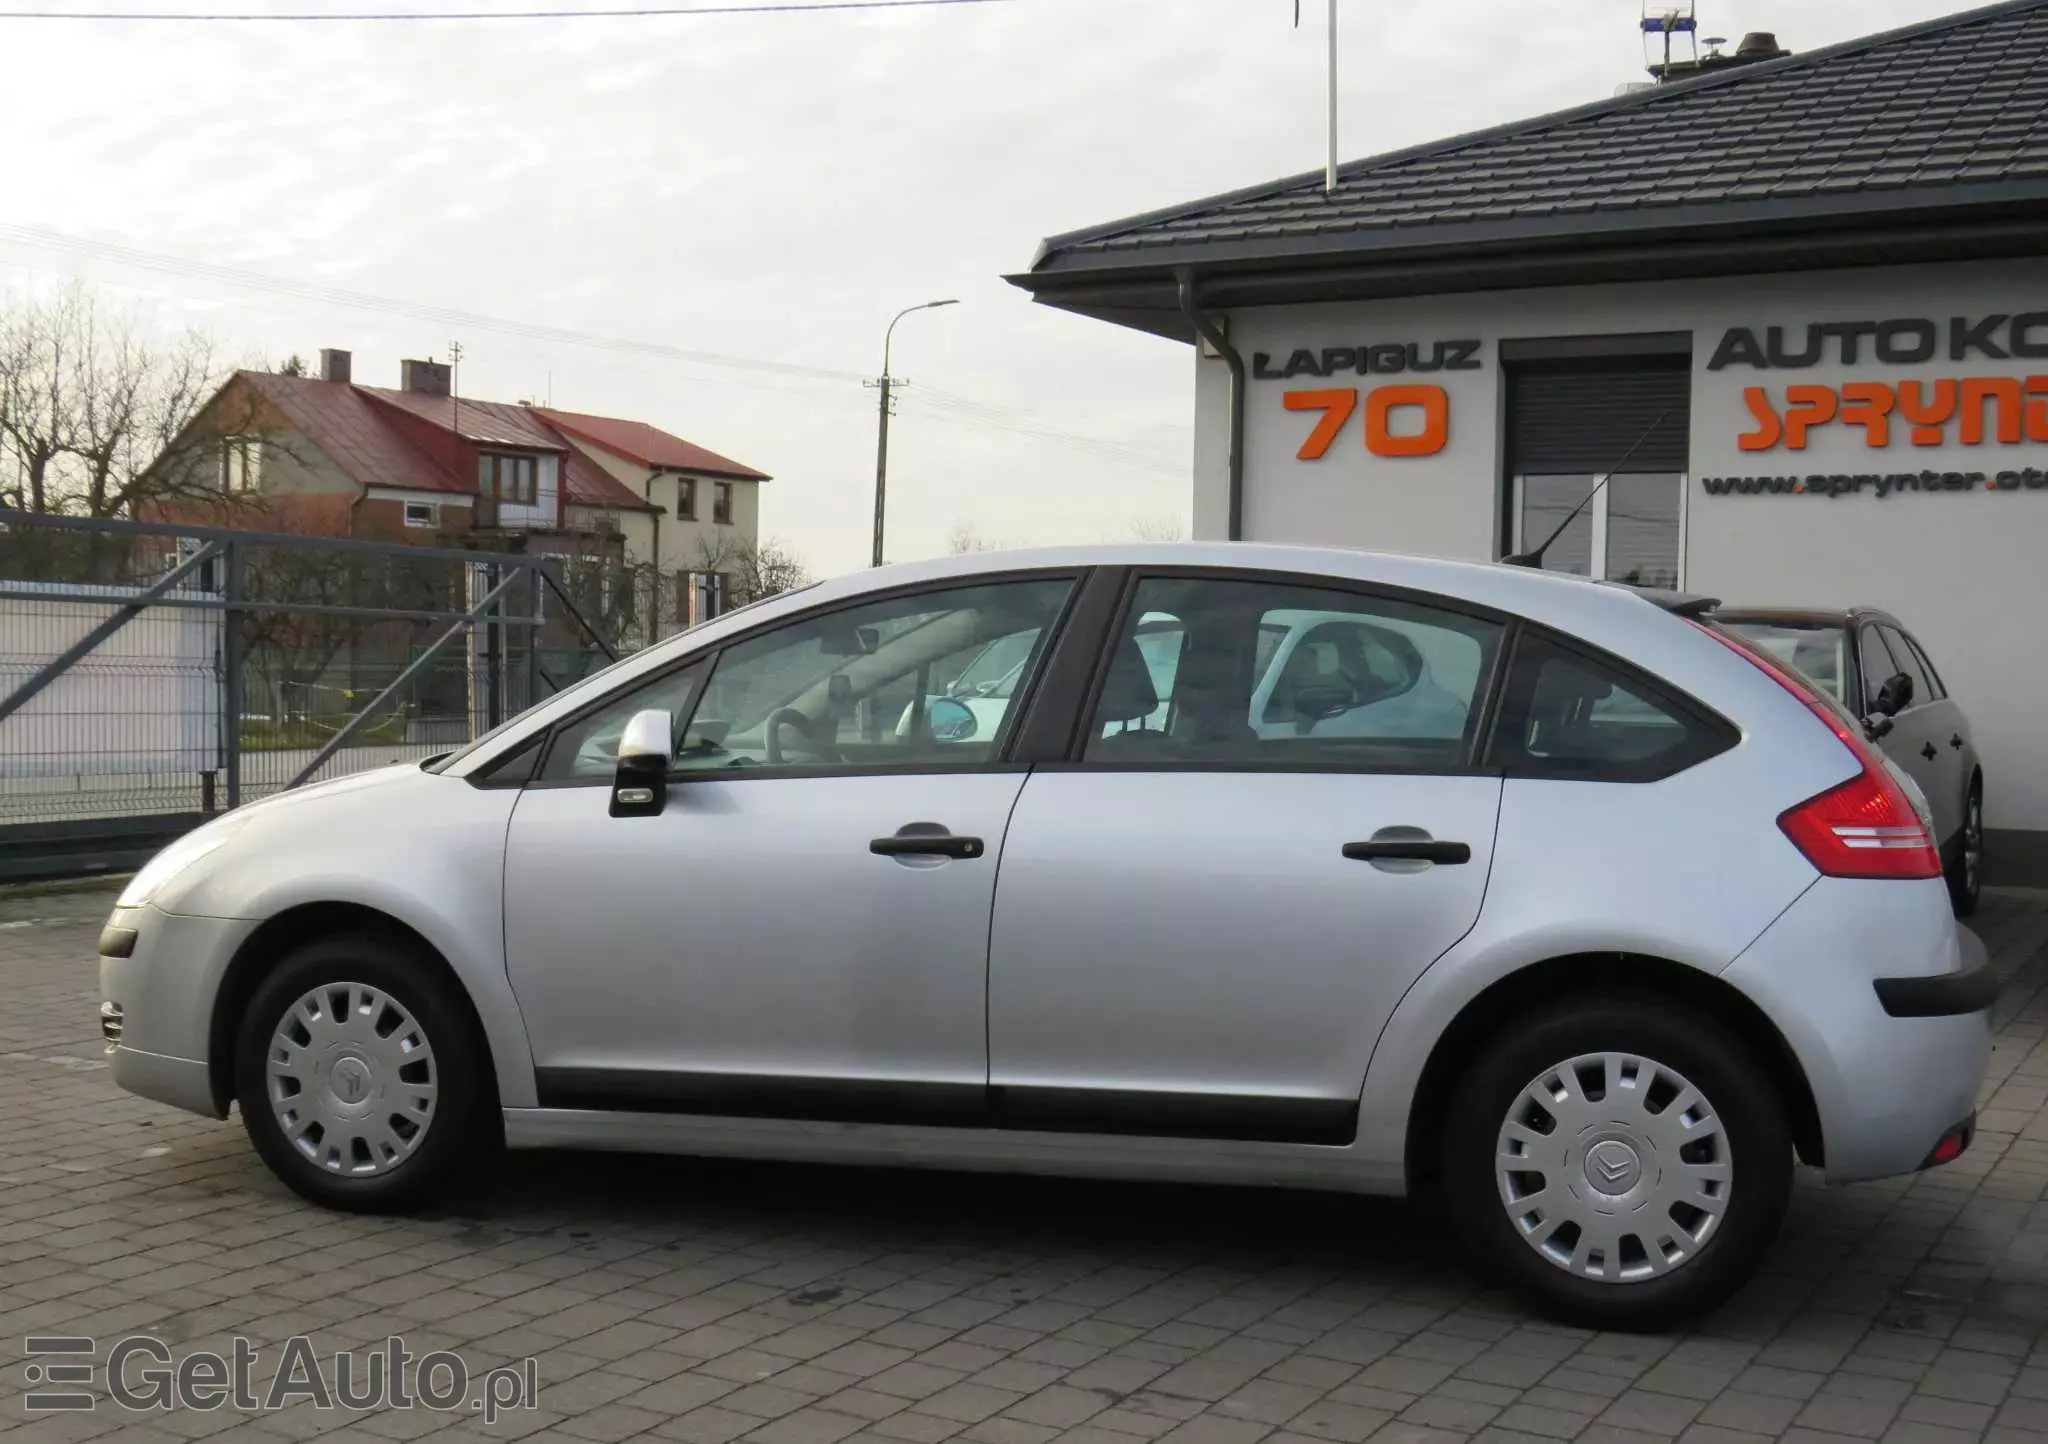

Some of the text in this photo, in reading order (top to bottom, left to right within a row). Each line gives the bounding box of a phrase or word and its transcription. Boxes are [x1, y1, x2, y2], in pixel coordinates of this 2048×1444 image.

[1706, 318, 1937, 371] AUTO
[1282, 383, 1449, 460] 70
[1701, 467, 2048, 498] www.sprynter.ot
